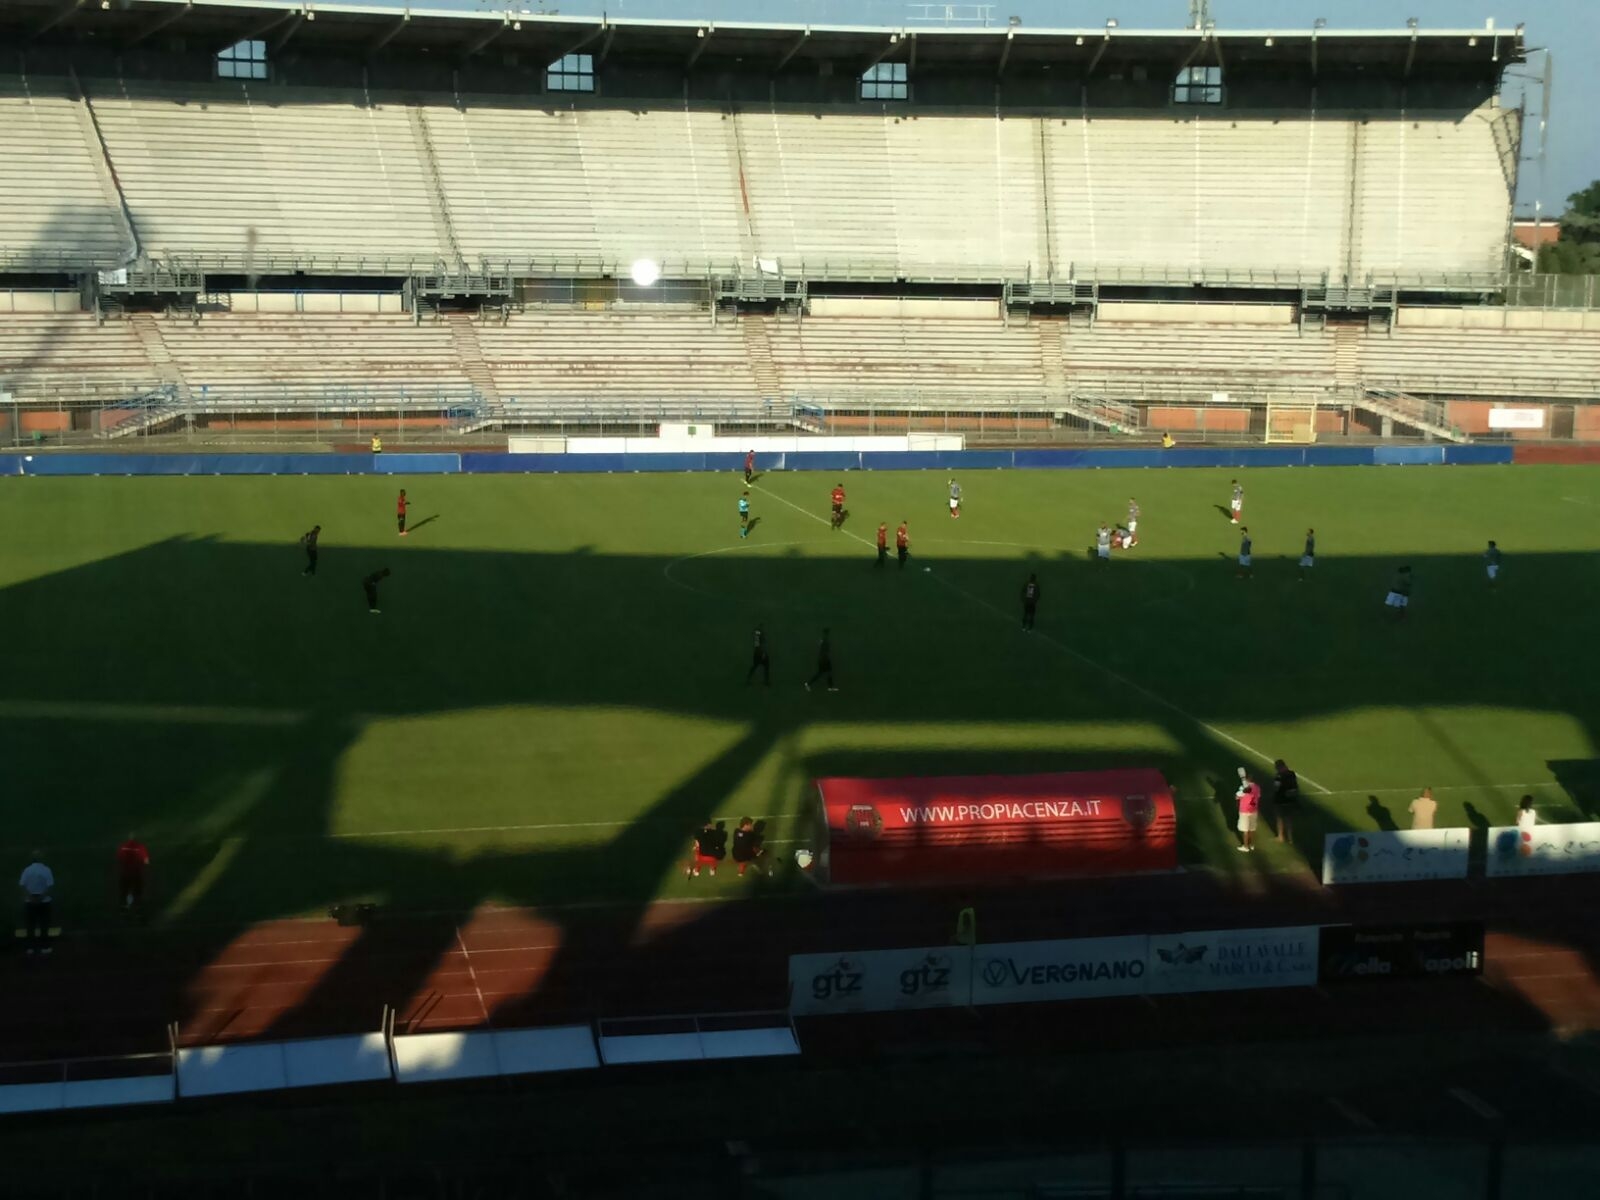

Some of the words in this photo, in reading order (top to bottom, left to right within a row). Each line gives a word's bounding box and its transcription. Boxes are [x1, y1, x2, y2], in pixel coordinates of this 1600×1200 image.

[899, 799, 1102, 823] WWW.PROPIACENZA.IT
[1007, 957, 1145, 986] VERGNANO
[1416, 947, 1479, 974] apoli
[812, 969, 864, 1000] gtz
[900, 964, 951, 995] gtz
